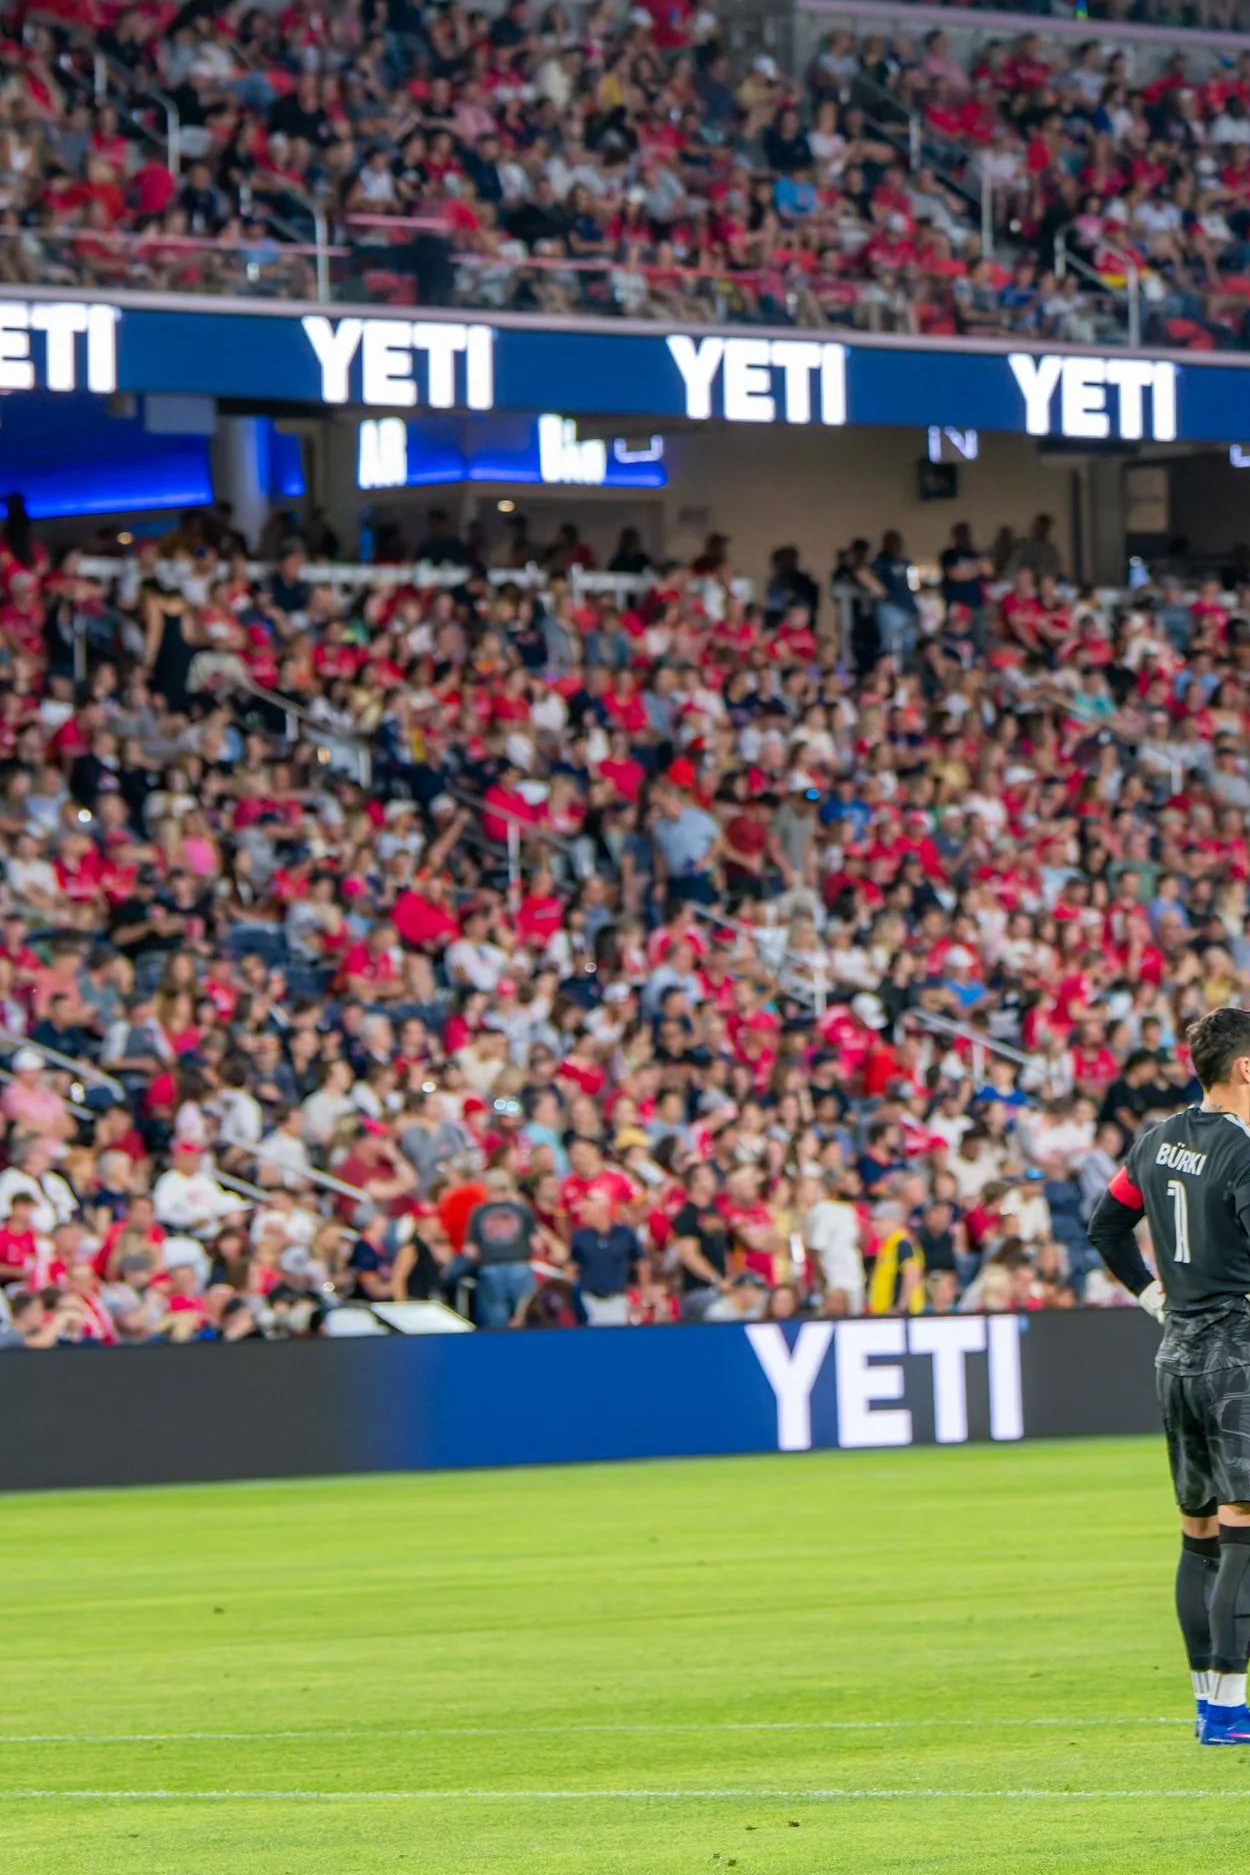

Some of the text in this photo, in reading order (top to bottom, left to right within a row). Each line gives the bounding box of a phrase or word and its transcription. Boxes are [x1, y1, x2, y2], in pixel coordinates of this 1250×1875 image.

[0, 302, 117, 394] ETI
[302, 316, 493, 410] YETI
[667, 335, 846, 425] YETI
[1009, 354, 1176, 440] YETI
[1155, 1142, 1207, 1176] BÜRKI
[1167, 1180, 1191, 1264] 1
[745, 1315, 1023, 1450] YETI
